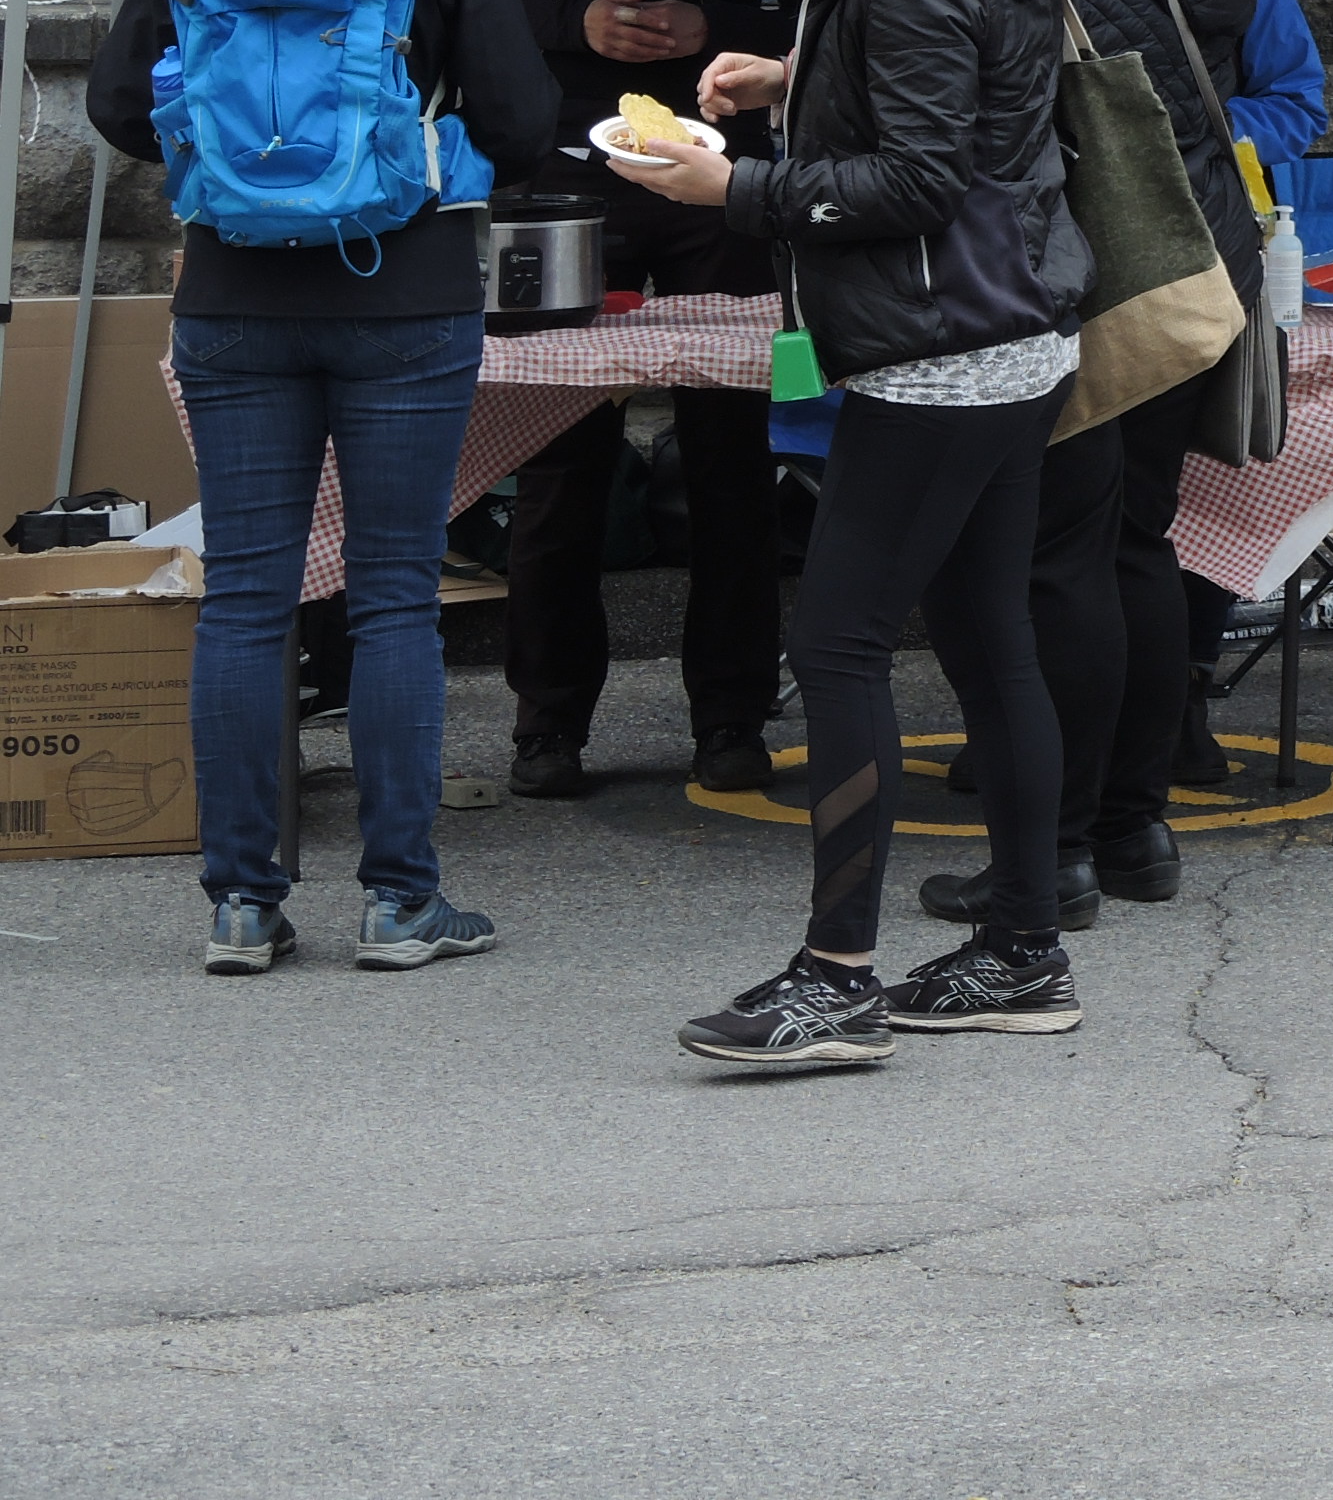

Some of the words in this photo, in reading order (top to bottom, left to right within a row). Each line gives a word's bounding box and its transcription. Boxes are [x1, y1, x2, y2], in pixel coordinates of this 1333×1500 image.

[0, 645, 29, 655] RD
[41, 660, 78, 670] MASKS
[12, 685, 40, 695] AVEC
[111, 679, 188, 691] AURICULAIRES
[3, 733, 81, 757] 9050
